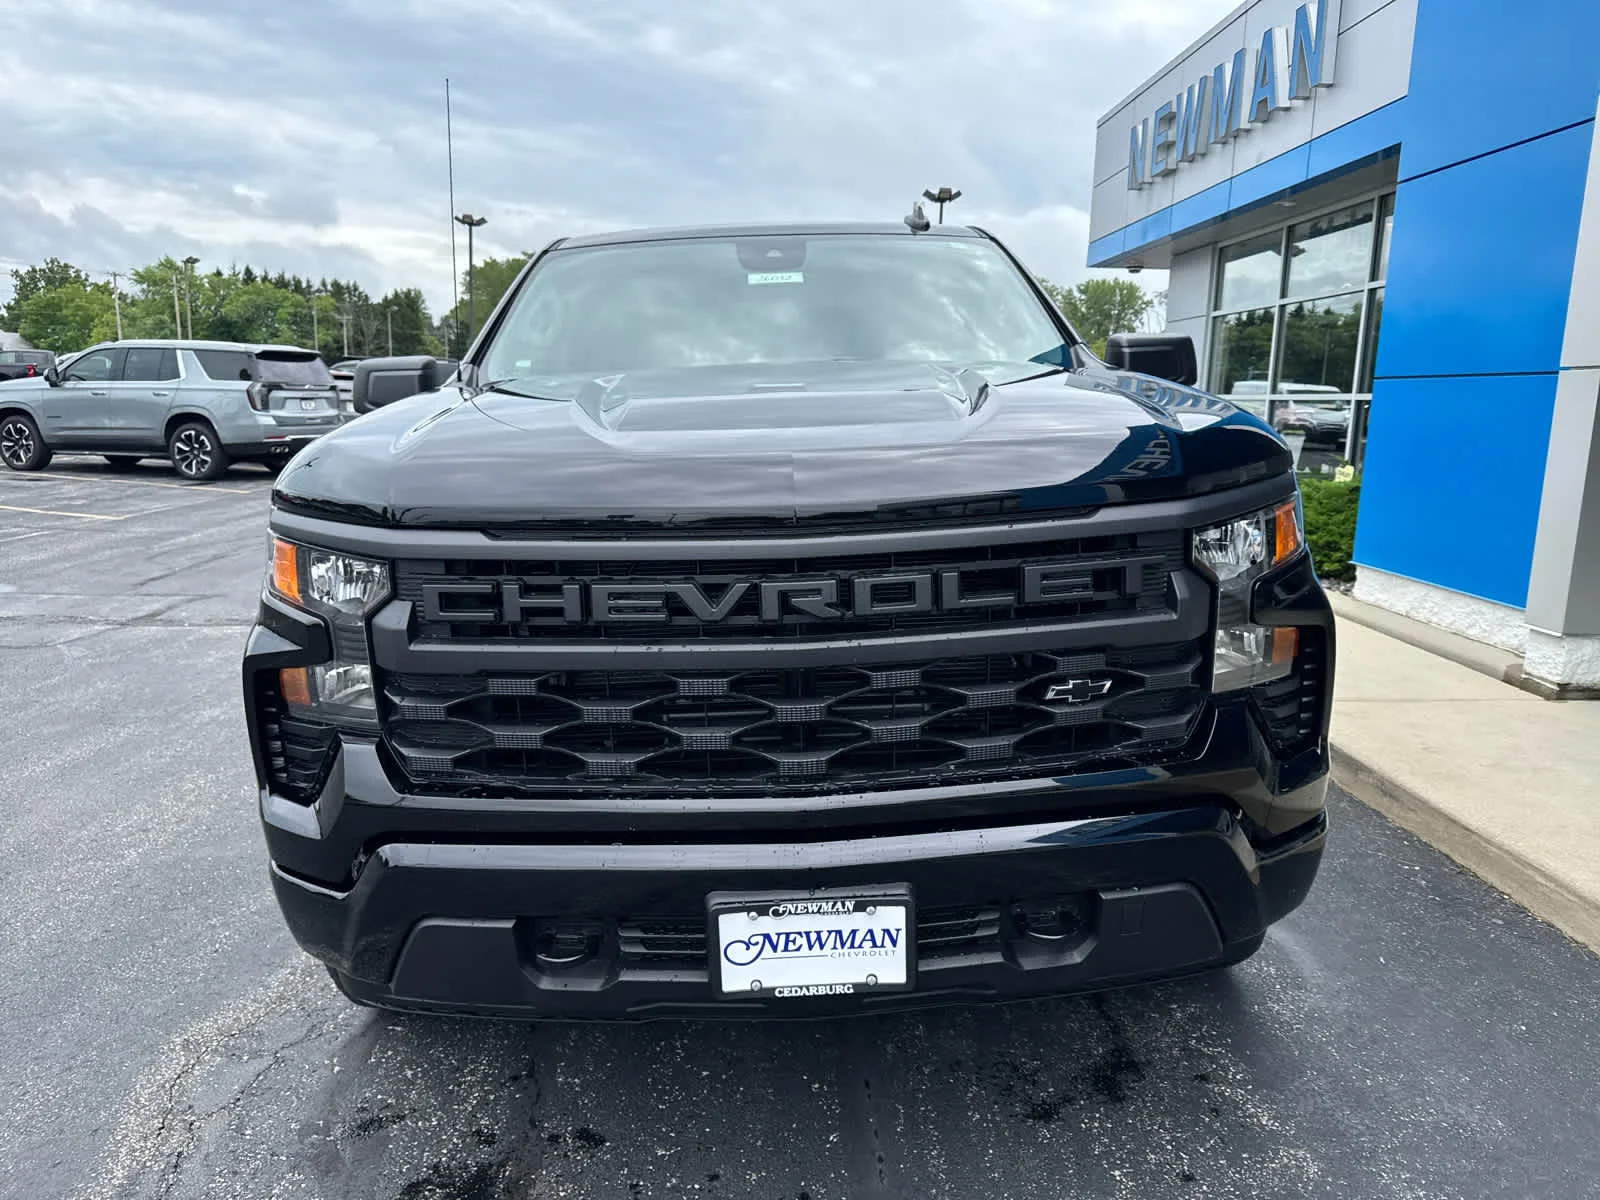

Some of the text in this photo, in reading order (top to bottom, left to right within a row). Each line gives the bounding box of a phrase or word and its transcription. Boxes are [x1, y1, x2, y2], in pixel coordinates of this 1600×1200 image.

[1128, 0, 1334, 190] NEWMAN
[422, 553, 1167, 622] CHEVROLET
[769, 901, 855, 920] NEWMAN
[724, 928, 902, 966] NEWMAN
[829, 949, 896, 959] CHEVROLET
[775, 984, 854, 998] CEDARBURG
